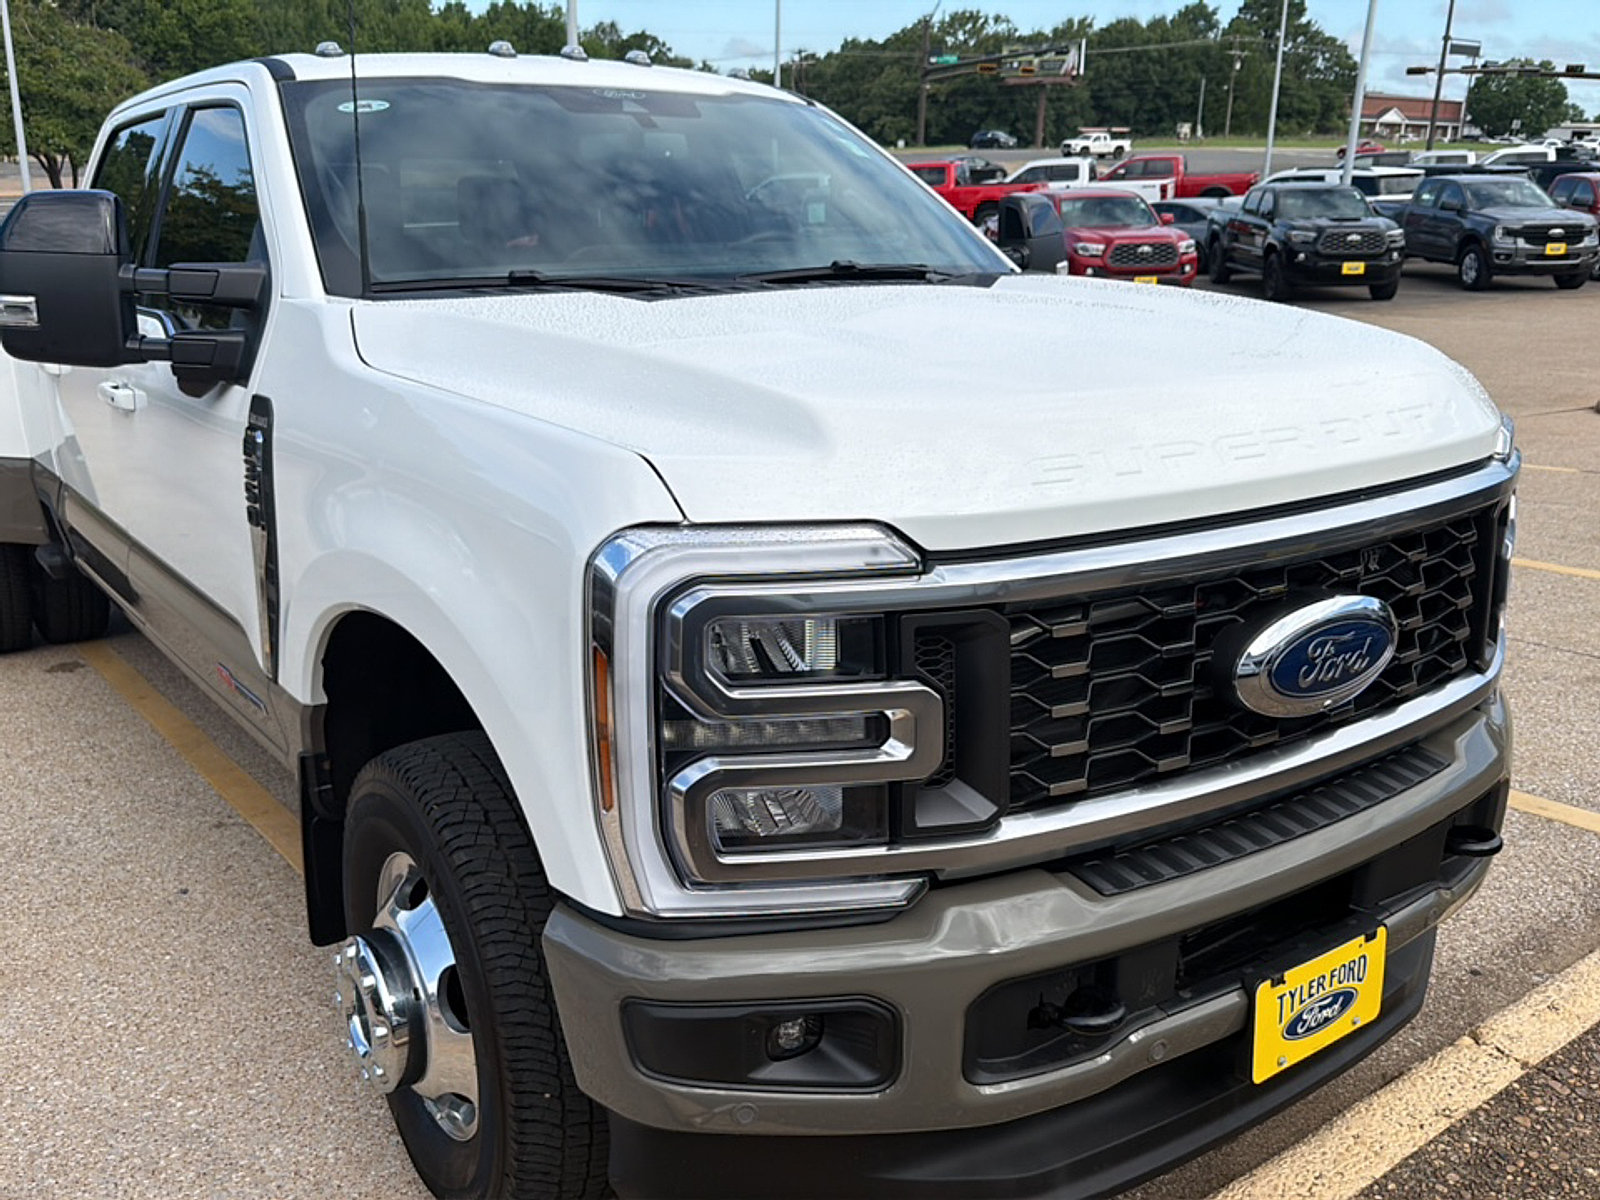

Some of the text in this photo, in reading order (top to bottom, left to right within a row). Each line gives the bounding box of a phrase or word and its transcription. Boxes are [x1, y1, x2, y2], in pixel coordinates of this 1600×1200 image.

[1030, 424, 1314, 486] SUPER
[1298, 630, 1373, 689] Ford
[1276, 953, 1368, 1026] TYLER FORD
[1296, 995, 1345, 1035] Ford
